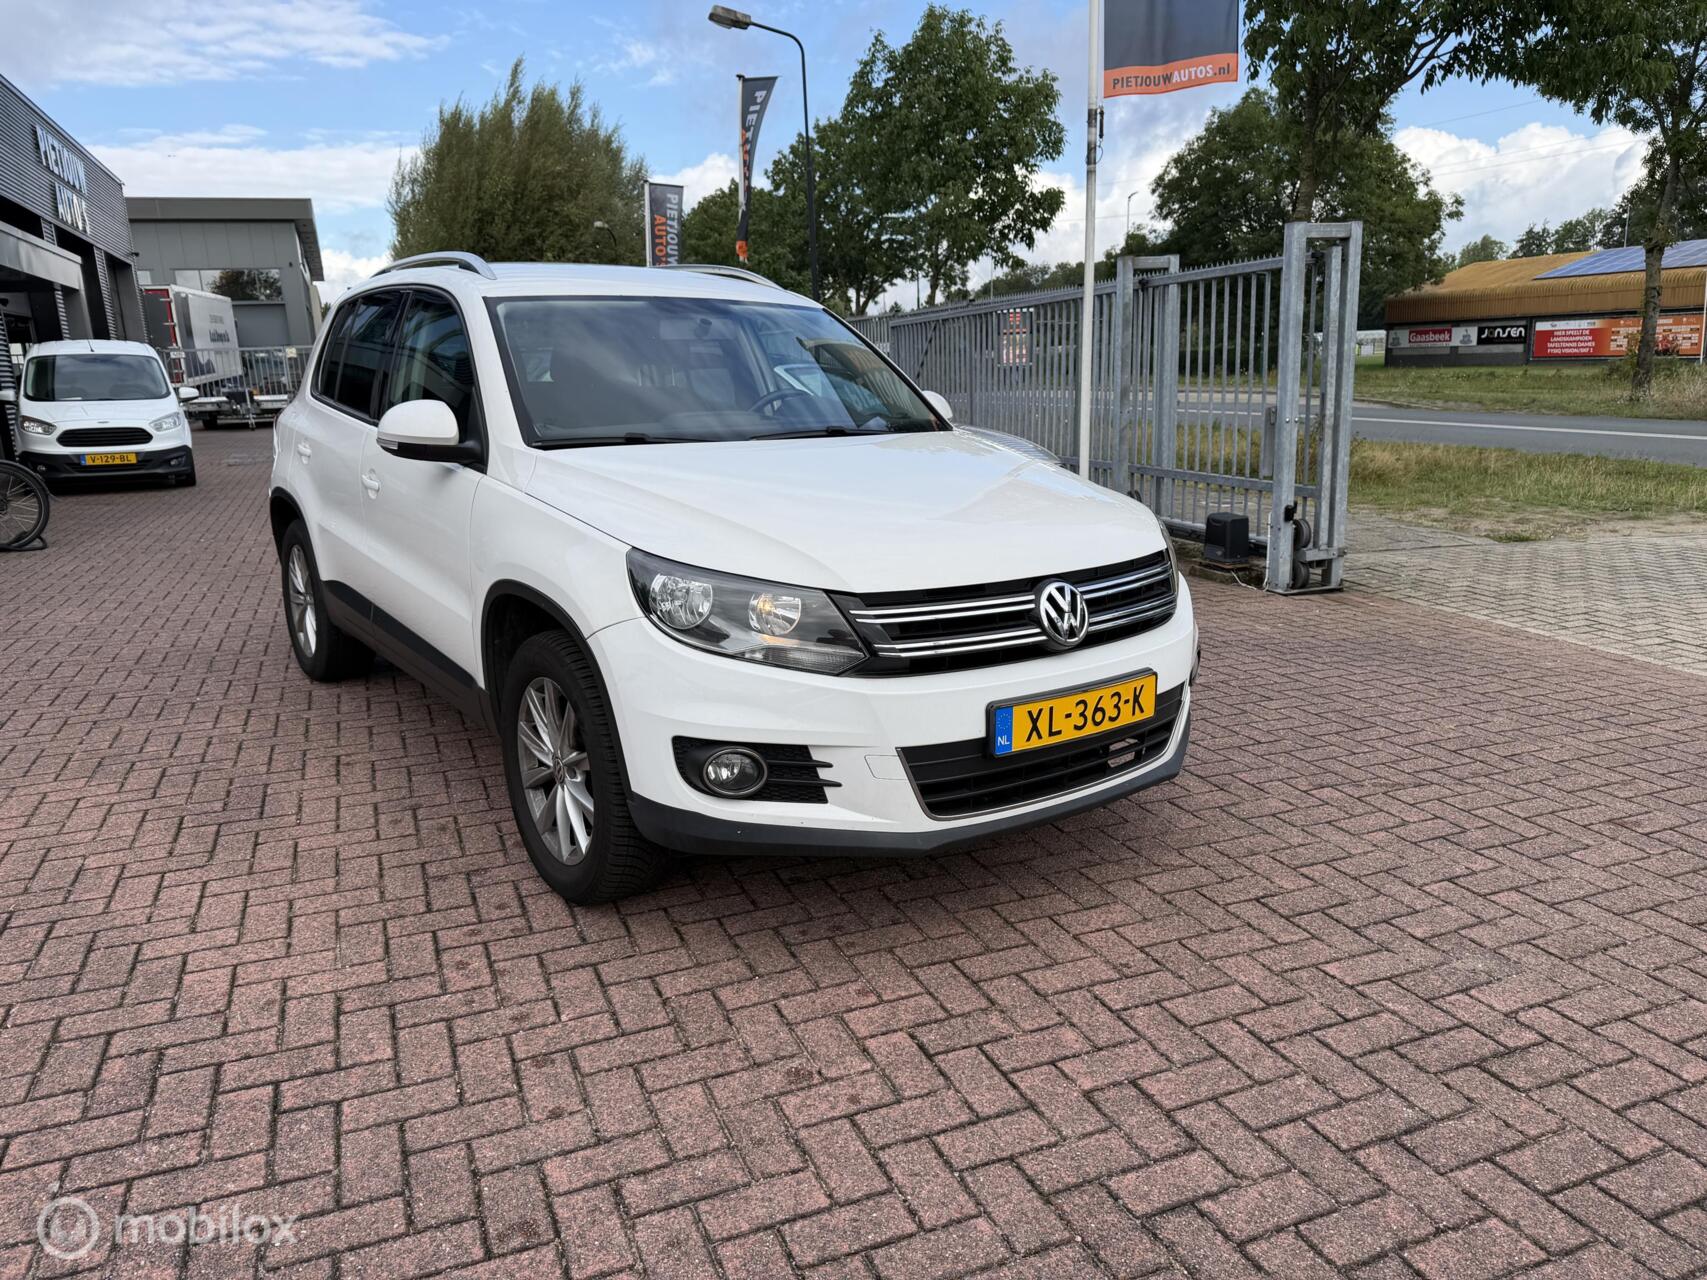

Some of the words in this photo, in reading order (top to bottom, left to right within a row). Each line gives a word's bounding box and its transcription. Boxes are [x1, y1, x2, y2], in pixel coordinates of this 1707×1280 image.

[1112, 63, 1231, 90] PIETJOUWAUTOS.nl
[1409, 330, 1451, 342] Gaasbeek
[90, 454, 132, 463] V-129-BL
[1025, 684, 1145, 743] XL-363-K
[997, 736, 1010, 746] NL
